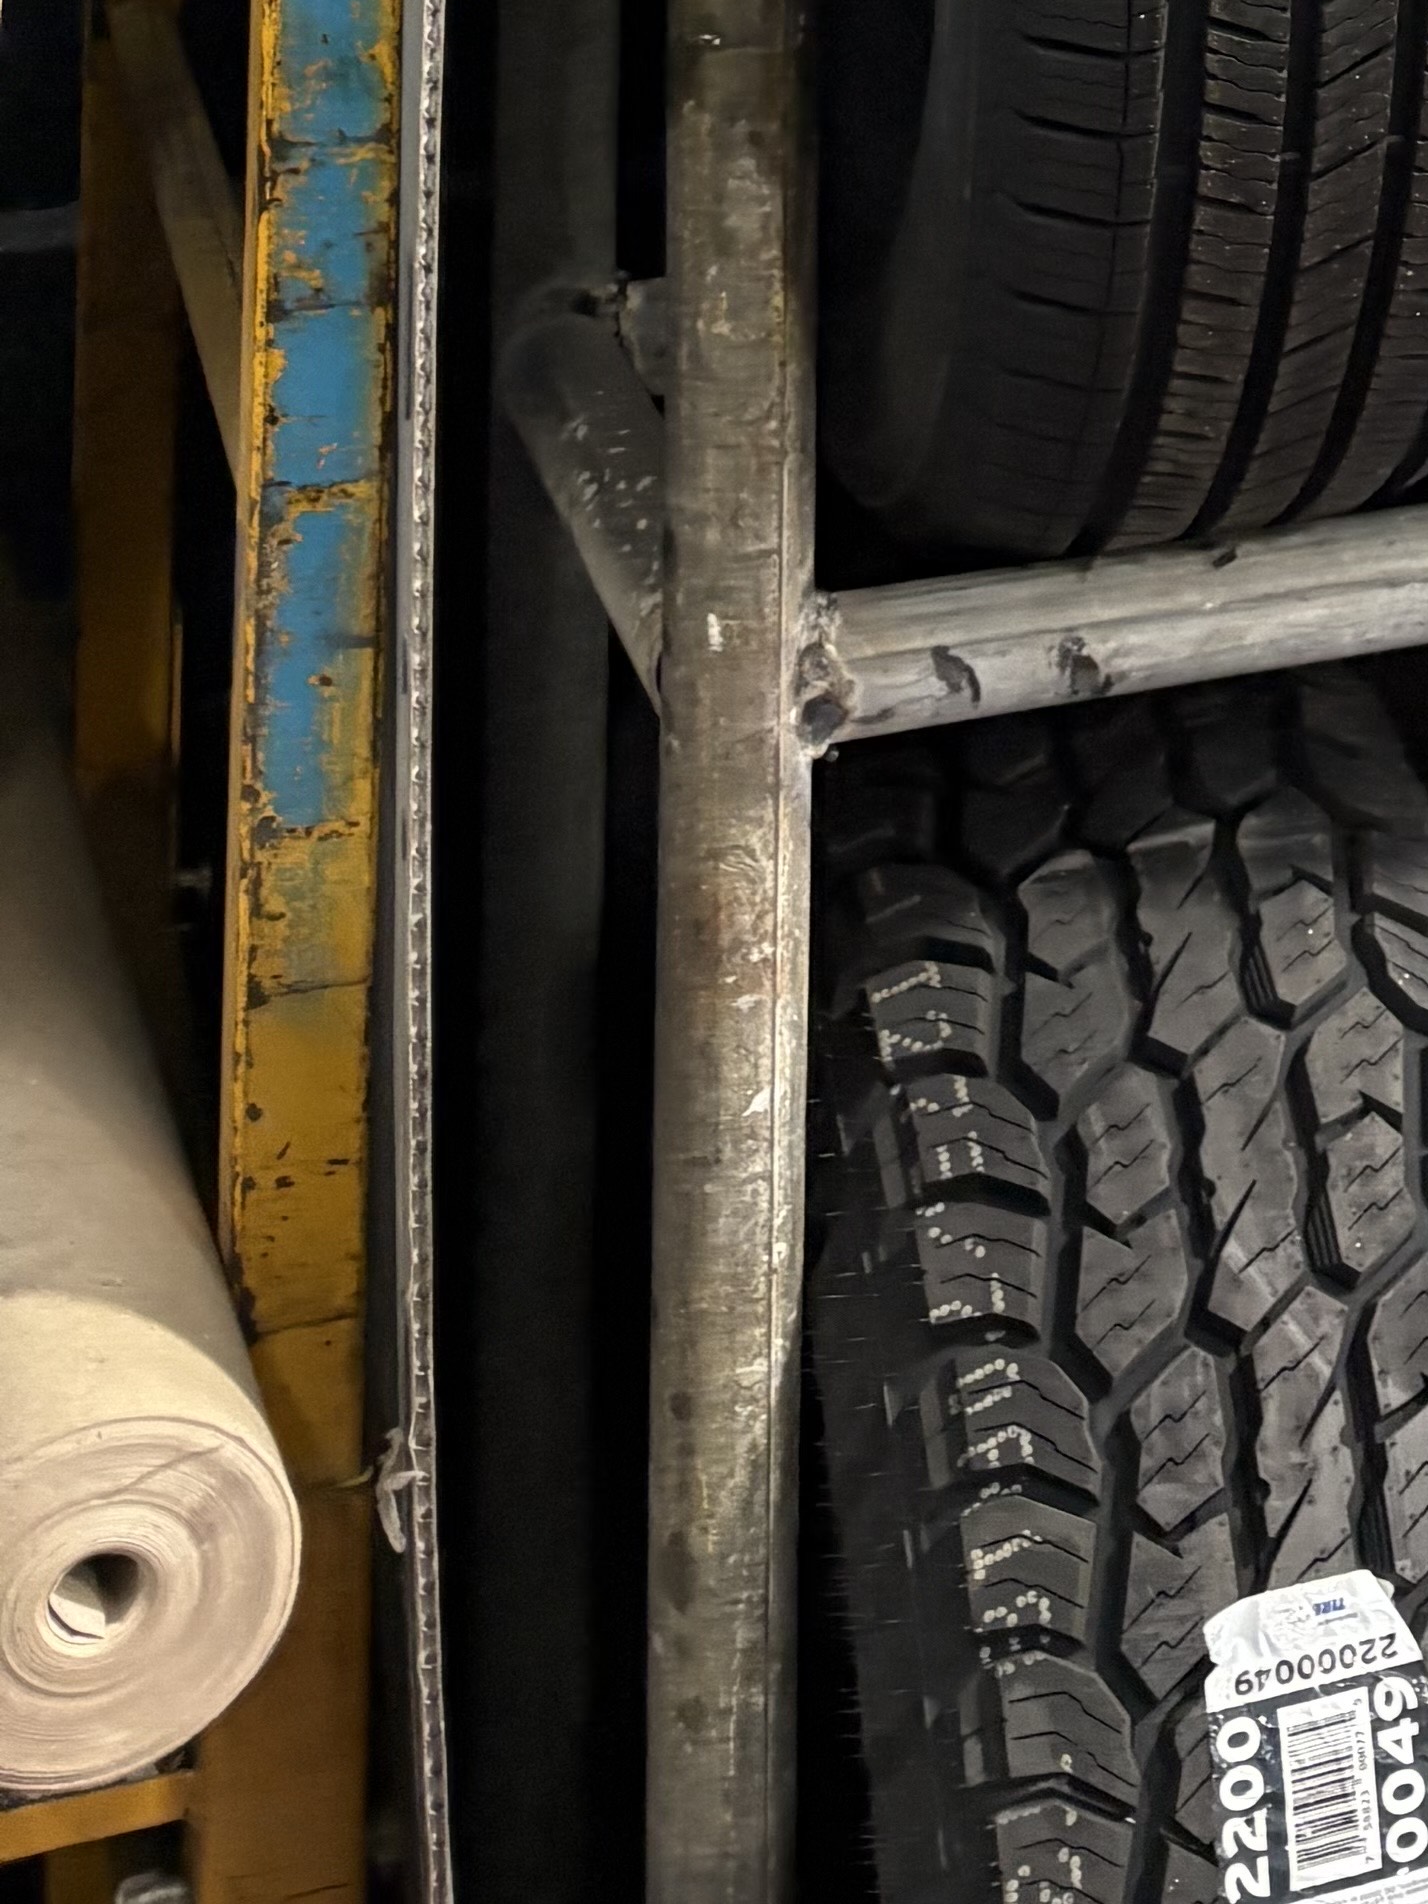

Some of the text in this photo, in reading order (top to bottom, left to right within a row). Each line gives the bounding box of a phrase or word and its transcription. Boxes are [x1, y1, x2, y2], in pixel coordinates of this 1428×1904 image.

[1234, 1632, 1398, 1695] 22000049
[1216, 1716, 1271, 1904] 2200
[1373, 1676, 1428, 1863] 0049
